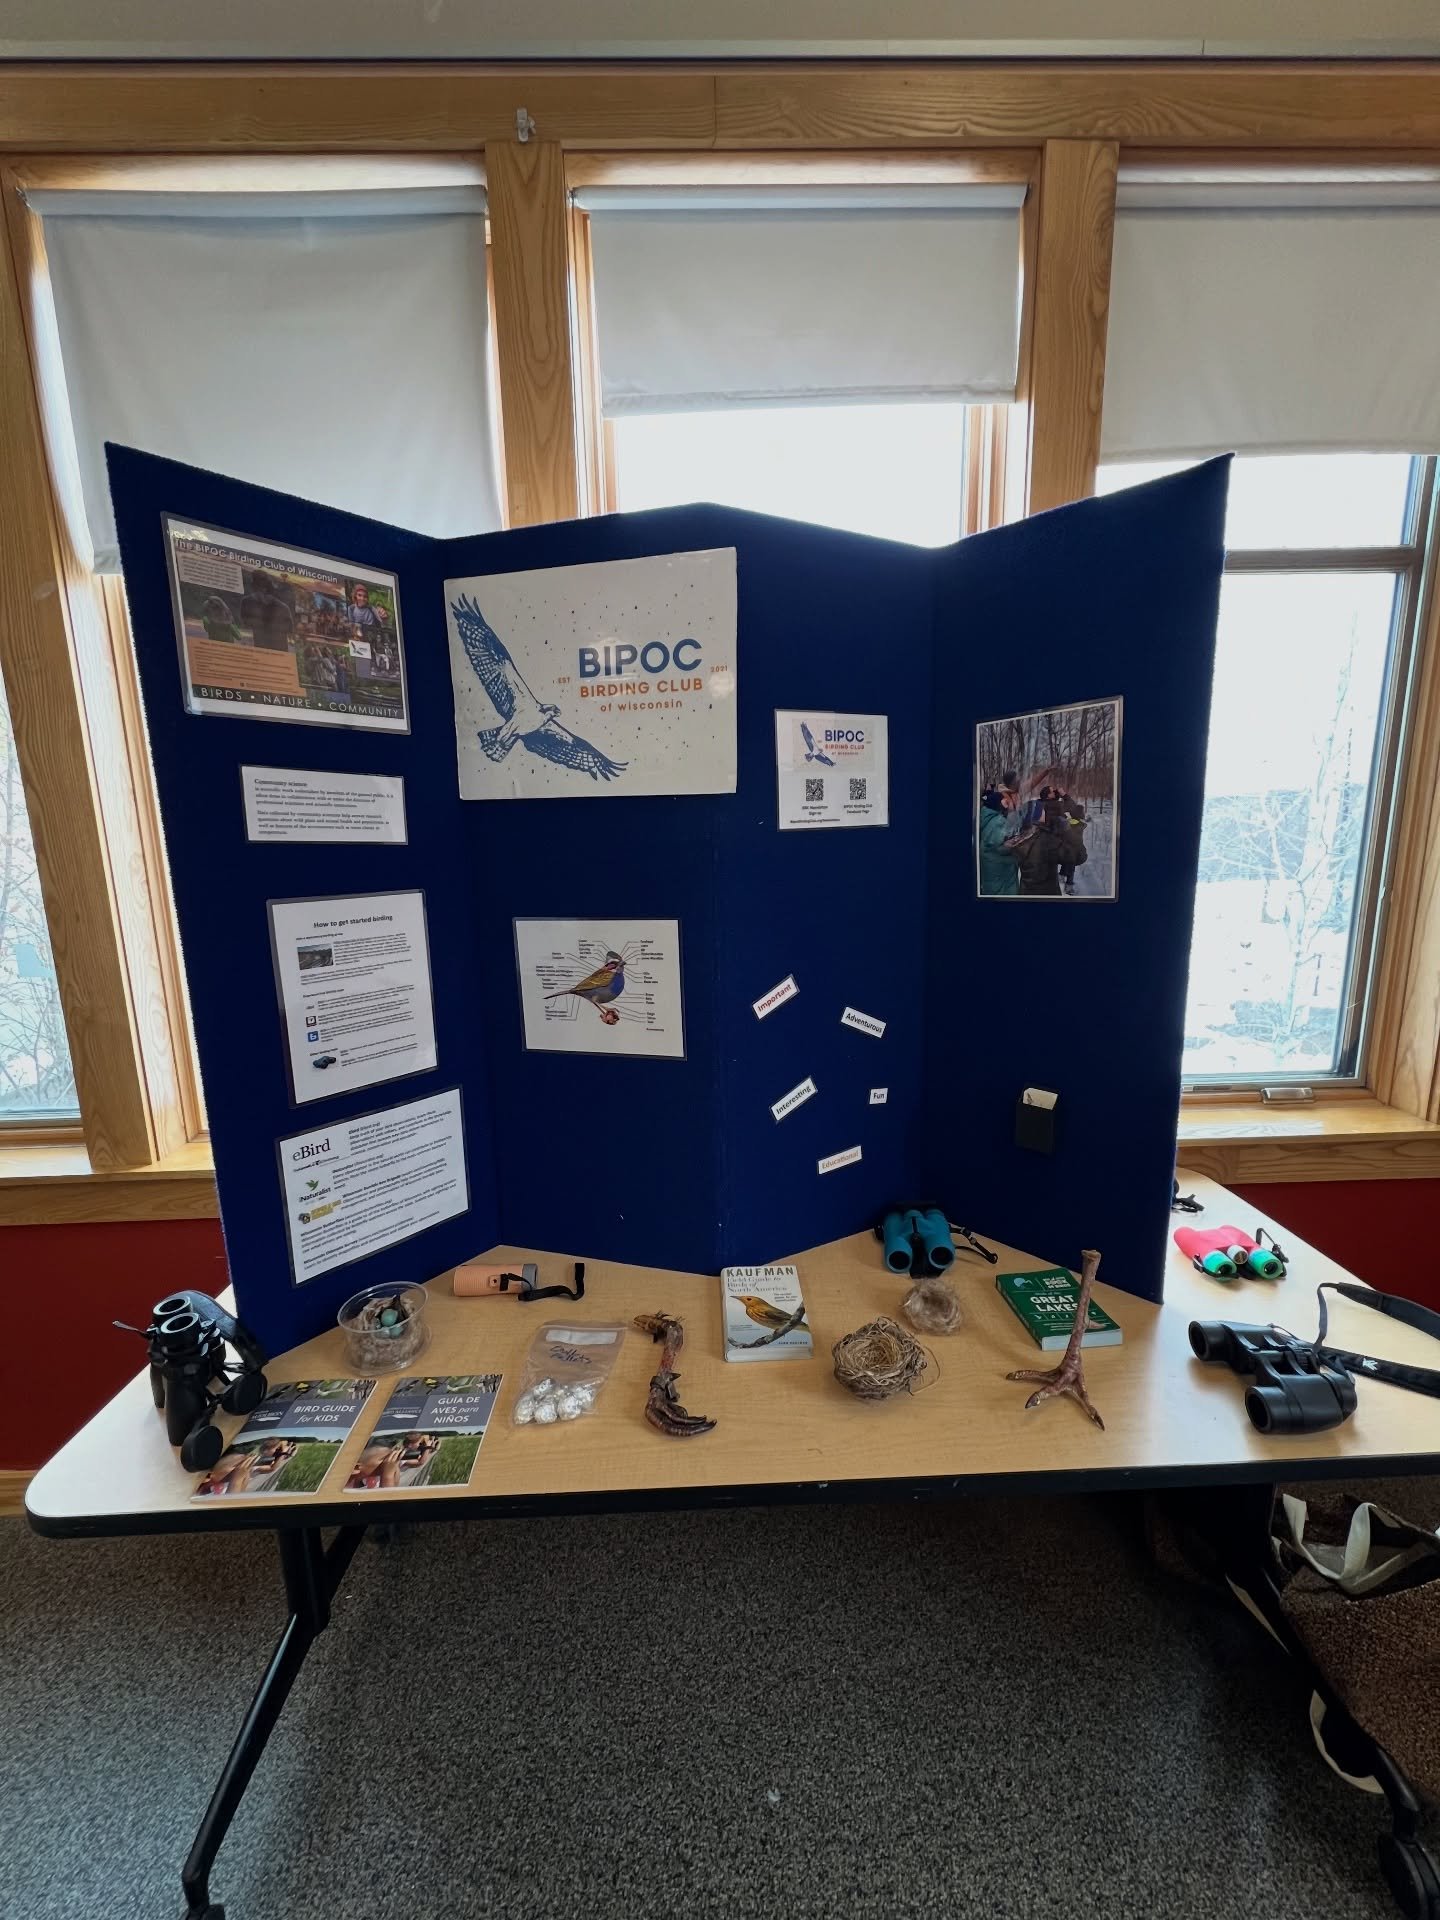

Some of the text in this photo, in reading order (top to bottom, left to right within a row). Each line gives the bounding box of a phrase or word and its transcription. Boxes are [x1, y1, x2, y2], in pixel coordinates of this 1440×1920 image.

[195, 542, 227, 558] BIPOC
[229, 551, 261, 568] Birding
[263, 559, 285, 572] Club
[287, 563, 296, 574] of
[298, 567, 338, 584] Wisconsin
[578, 638, 703, 679] BIPOC
[710, 665, 728, 673] 2021
[557, 676, 571, 684] EST
[580, 678, 703, 698] BIRDING CLUB
[201, 687, 399, 718] BIRDS NATURE COMMUNITY
[600, 699, 683, 713] of wisconsin
[824, 729, 865, 743] BIPOC
[338, 919, 349, 927] get
[349, 916, 372, 925] started
[372, 914, 393, 923] birding
[757, 983, 793, 1013] Important
[845, 1012, 883, 1034] Adventurous
[776, 1084, 812, 1115] Interesting
[873, 1092, 885, 1100] Fun
[292, 1137, 331, 1161] eBird
[821, 1149, 859, 1170] Educational
[726, 1266, 794, 1277] KAUFMAN
[1030, 1294, 1074, 1304] GREAT
[1035, 1302, 1079, 1312] LAKES
[437, 1396, 481, 1405] GUÍA DE
[294, 1405, 320, 1413] BIRD
[430, 1406, 457, 1414] AVES
[295, 1414, 340, 1424] for KIDS
[433, 1414, 470, 1424] NIÑOS
